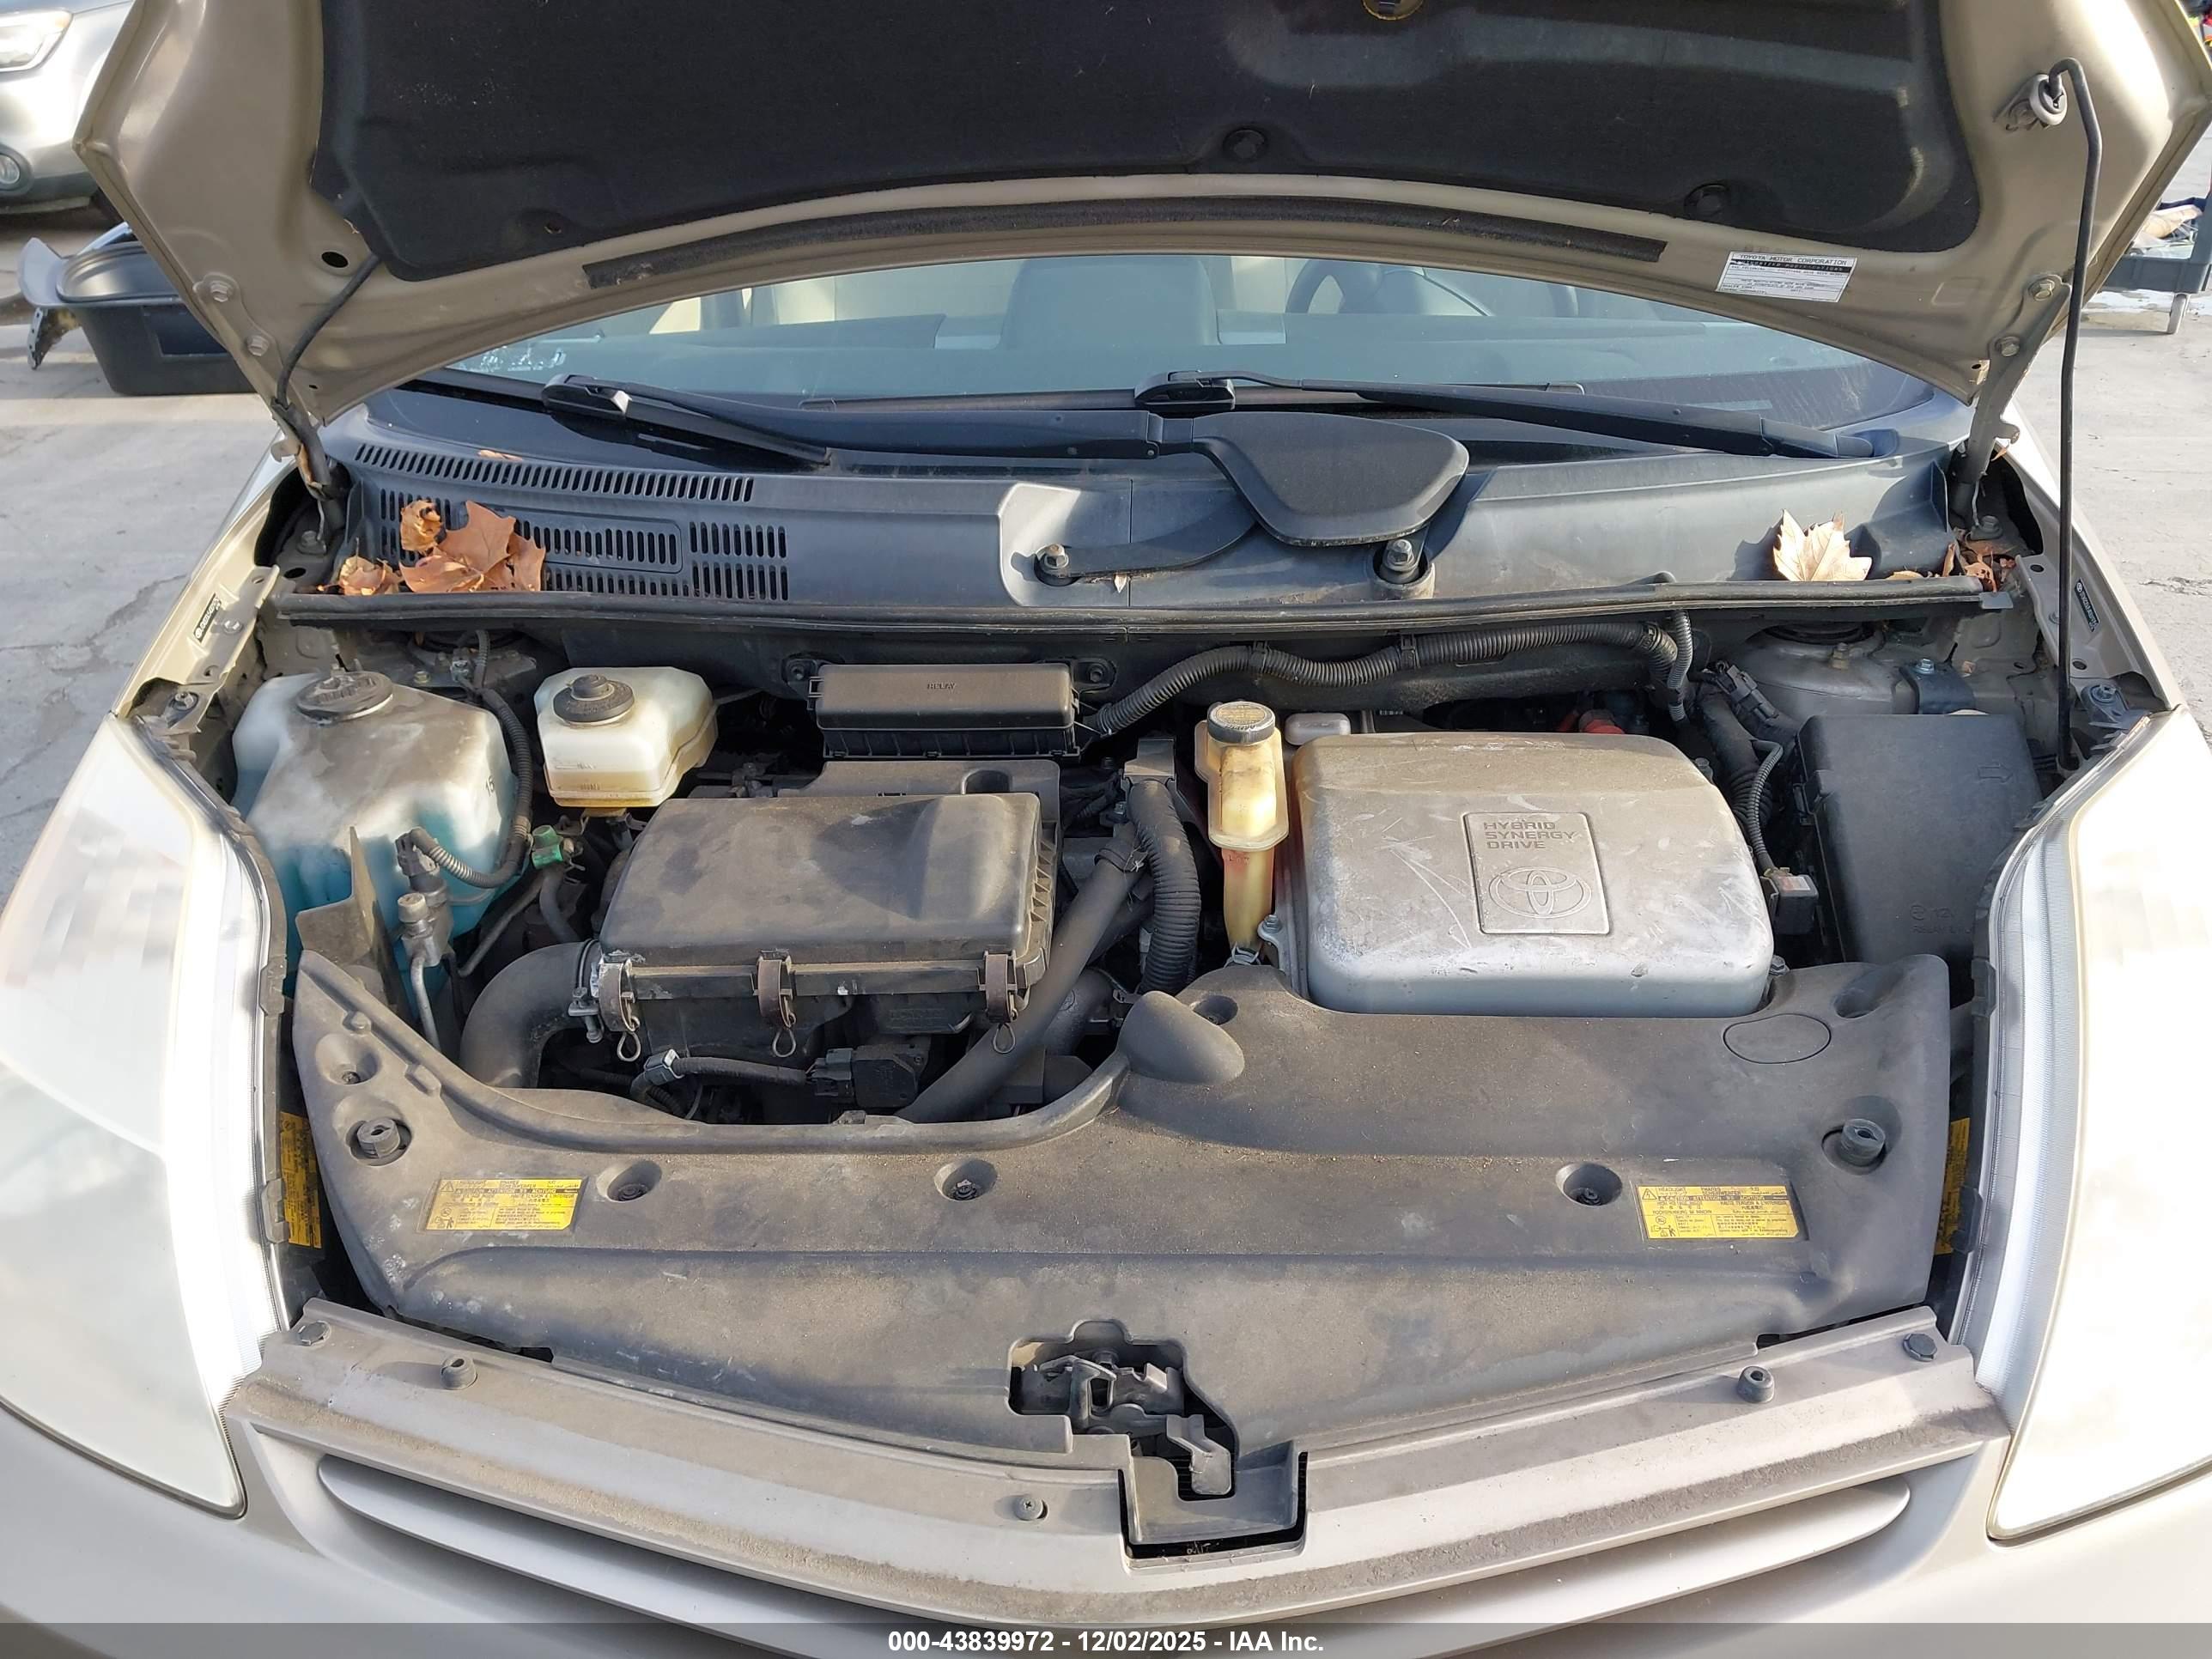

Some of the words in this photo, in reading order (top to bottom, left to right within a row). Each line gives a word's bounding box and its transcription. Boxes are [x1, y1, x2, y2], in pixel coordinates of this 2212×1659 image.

[927, 682, 956, 690] RELAY
[1484, 822, 1556, 830] HYBRID
[1485, 831, 1576, 840] SYNERGY
[1486, 841, 1547, 849] DRIVE
